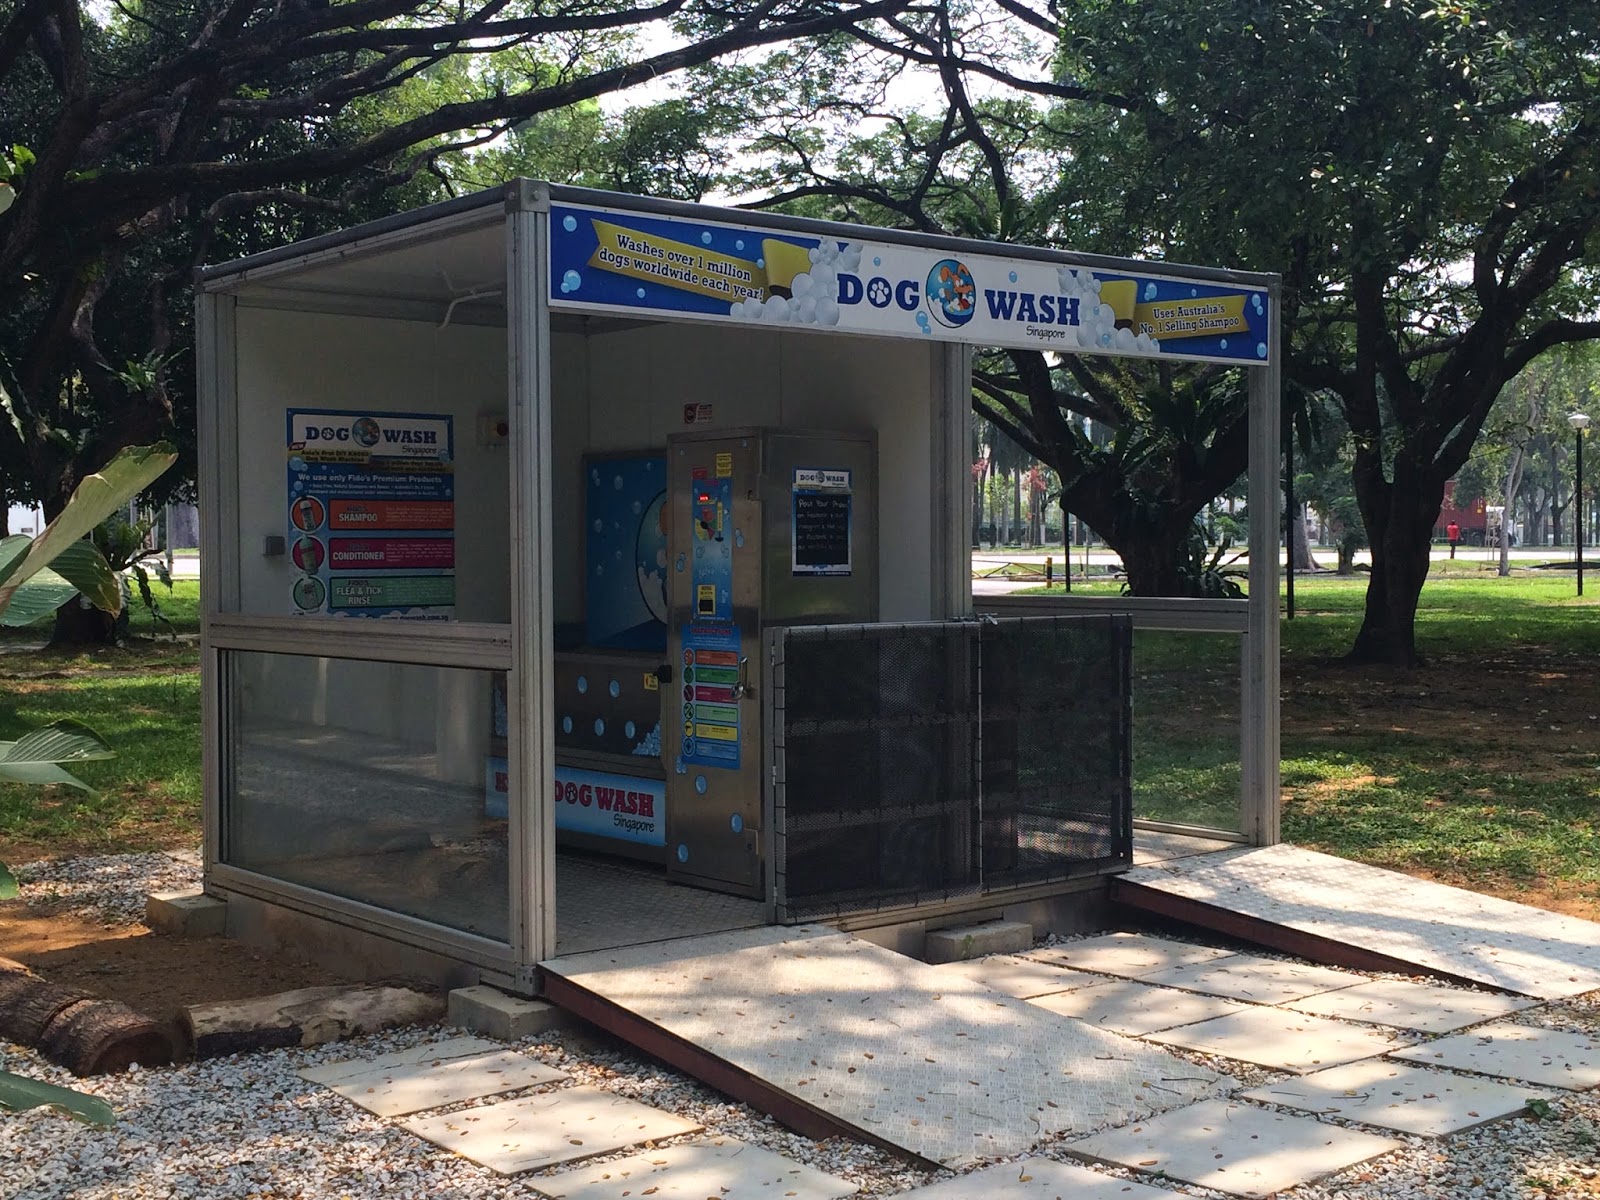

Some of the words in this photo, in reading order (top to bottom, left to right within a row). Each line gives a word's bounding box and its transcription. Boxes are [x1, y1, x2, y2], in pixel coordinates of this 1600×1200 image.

[616, 233, 665, 259] Washes
[667, 249, 695, 267] over
[698, 256, 704, 270] 1
[706, 260, 752, 283] million
[599, 248, 630, 270] dogs
[633, 256, 699, 285] worldwide
[701, 275, 731, 294] each
[733, 281, 764, 301] year!
[837, 273, 920, 311] DOG
[984, 289, 1081, 327] WASH
[1153, 307, 1175, 320] Uses
[1177, 302, 1226, 318] Australia's
[1026, 324, 1066, 340] Singapore
[1140, 322, 1156, 335] No.
[1158, 321, 1164, 333] 1
[1165, 318, 1197, 335] Selling
[1199, 315, 1240, 332] Shampoo
[305, 427, 350, 441] DOG
[383, 430, 437, 444] WASH
[402, 445, 437, 455] Singapore
[298, 473, 311, 482] We
[329, 474, 346, 483] only
[348, 474, 371, 483] Fido's
[373, 475, 407, 483] Premium
[339, 513, 378, 522] SHAMPOO
[332, 552, 385, 561] CONDITIONER
[336, 588, 354, 597] FLEA
[357, 588, 364, 596] &
[366, 587, 383, 596] TICK
[348, 597, 371, 605] RINSE
[595, 786, 655, 818] WASH
[614, 813, 656, 835] Singapore
